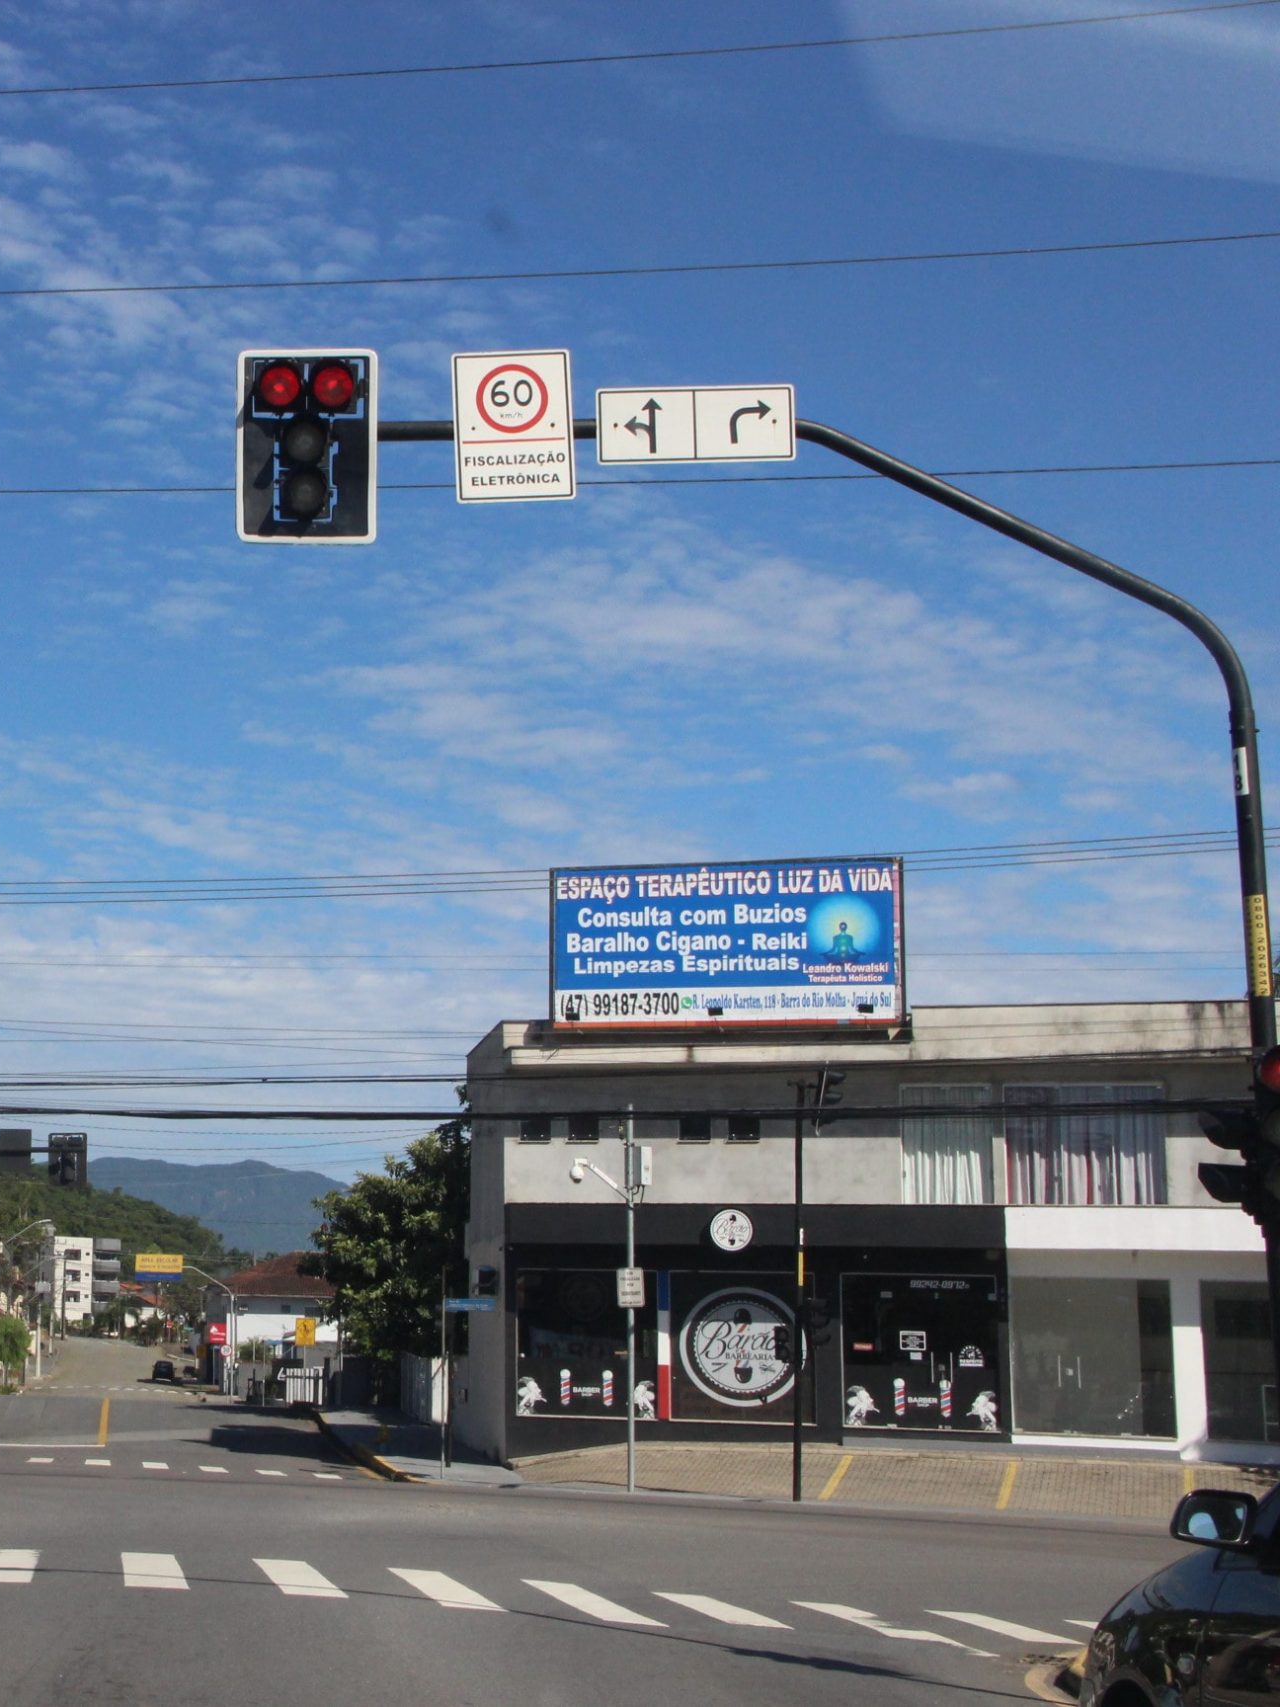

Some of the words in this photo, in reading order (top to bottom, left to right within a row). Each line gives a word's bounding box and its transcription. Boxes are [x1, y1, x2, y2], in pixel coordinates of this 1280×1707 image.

[491, 379, 533, 407] 60
[464, 451, 565, 466] FISCALIZAÇÃO
[471, 473, 560, 487] ELETRÔNICA
[556, 876, 630, 904] ESPAÇO
[635, 868, 770, 897] TERAPÊUTICO
[778, 869, 814, 894] LUZ
[819, 869, 844, 892] DA
[848, 867, 892, 892] VIDA
[577, 906, 672, 928] Consulta
[680, 909, 727, 926] com
[734, 903, 807, 924] Buzios
[567, 932, 649, 953] Baralho
[656, 931, 731, 956] Cigano
[752, 932, 807, 951] Reiki
[574, 957, 676, 978] Limpezas
[682, 954, 799, 976] Espirituais
[802, 963, 841, 973] Leandro
[844, 962, 889, 973] Kowalski
[561, 994, 589, 1016] (47)
[593, 992, 680, 1016] 99187-3700
[781, 992, 800, 1008] Barra
[802, 993, 810, 1008] do
[812, 992, 824, 1008] Rio
[880, 991, 892, 1008] Sul
